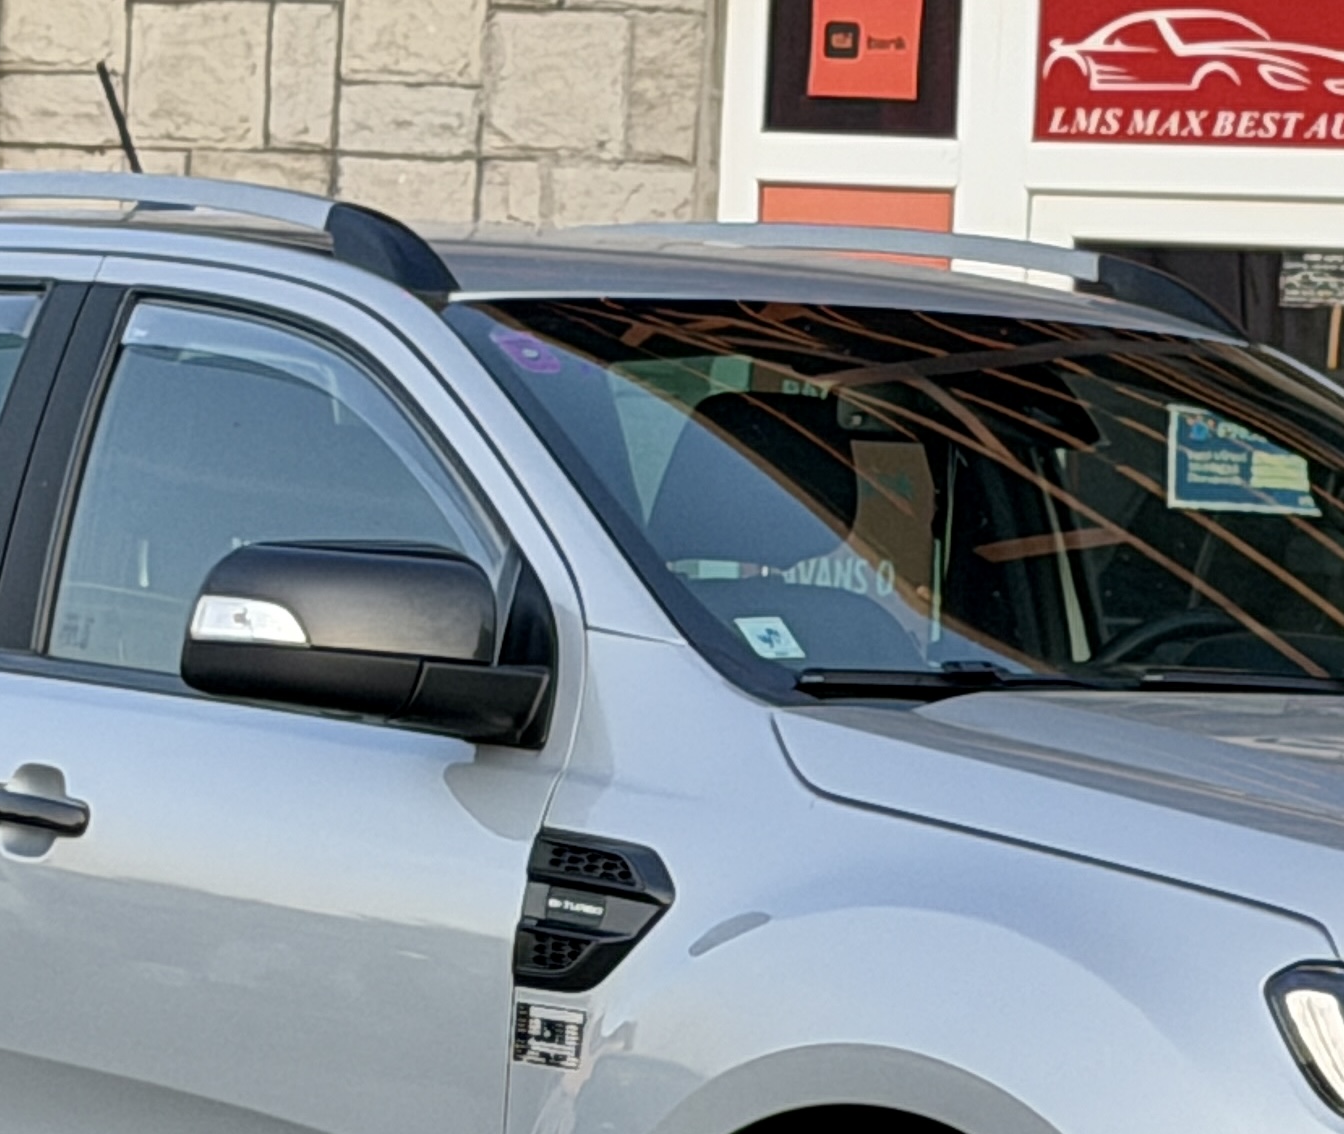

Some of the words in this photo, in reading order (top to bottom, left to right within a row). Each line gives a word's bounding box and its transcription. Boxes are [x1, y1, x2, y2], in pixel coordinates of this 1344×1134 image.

[1048, 107, 1123, 135] LMS
[1126, 109, 1209, 137] MAX
[1211, 110, 1304, 139] BEST
